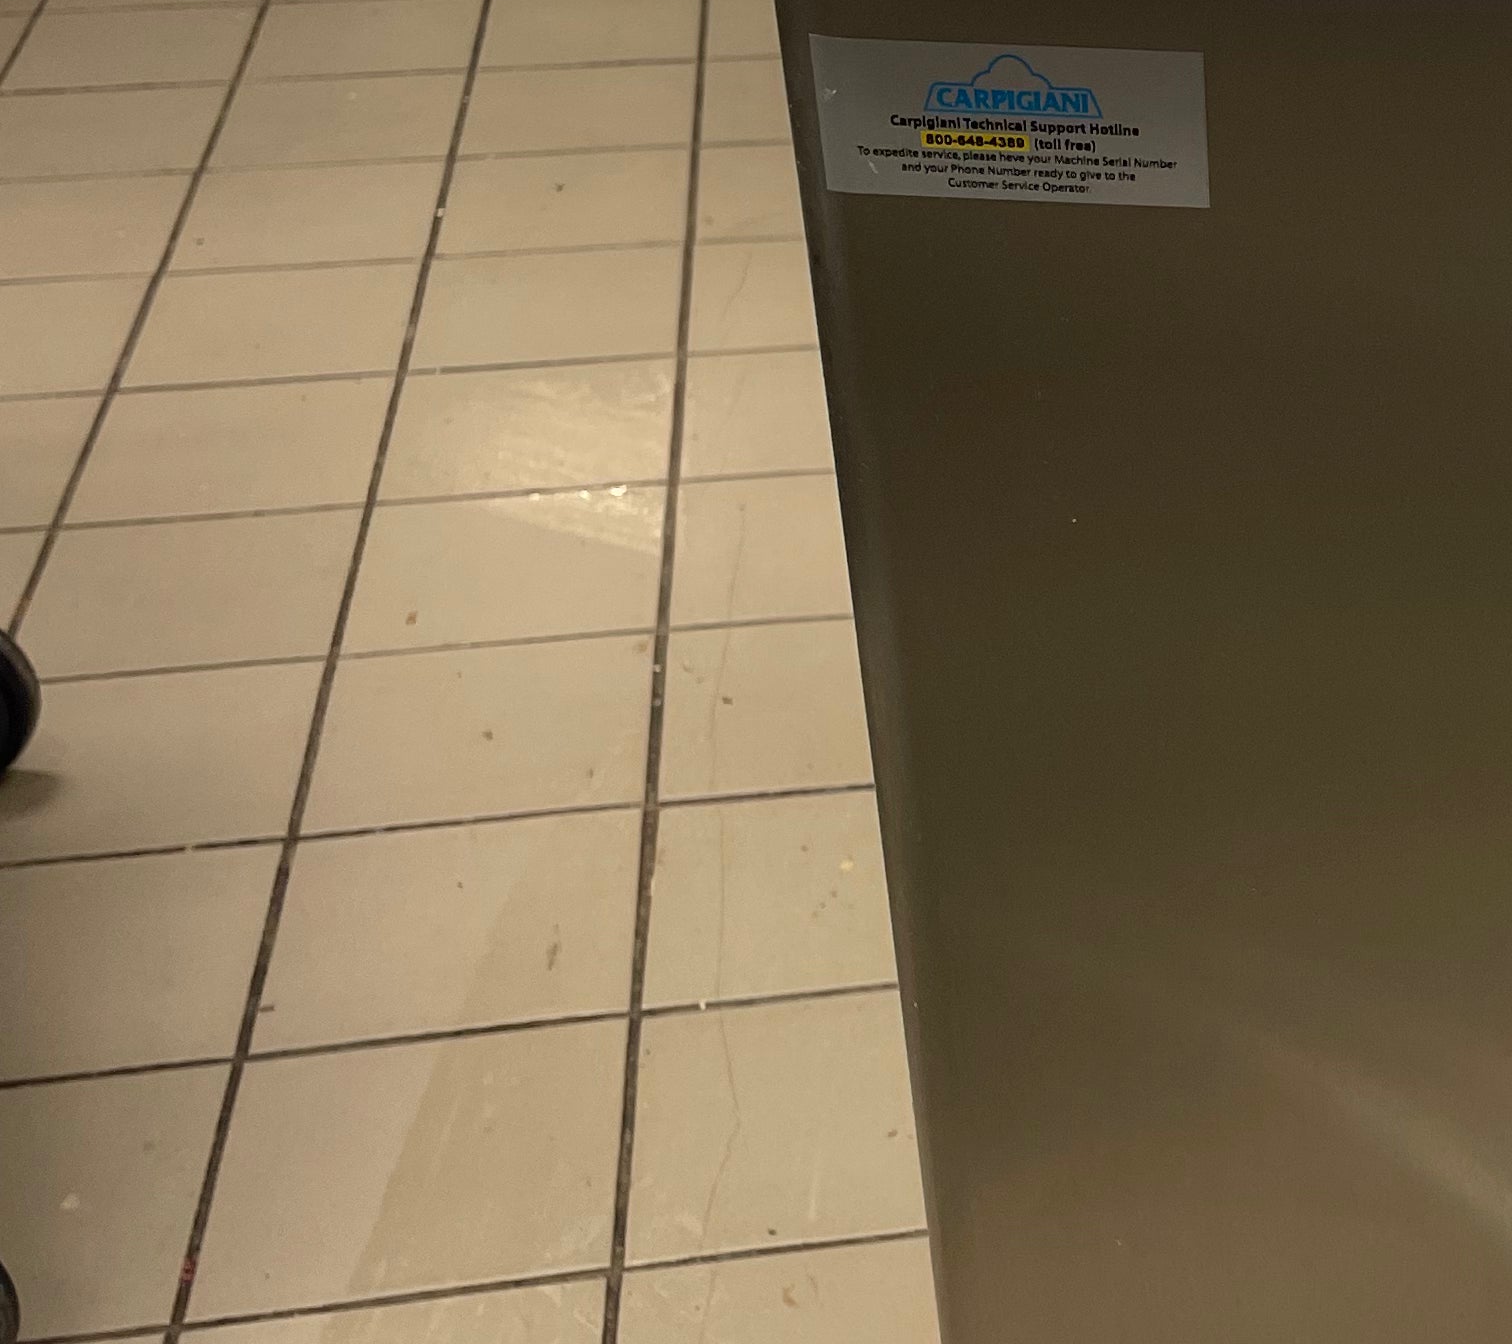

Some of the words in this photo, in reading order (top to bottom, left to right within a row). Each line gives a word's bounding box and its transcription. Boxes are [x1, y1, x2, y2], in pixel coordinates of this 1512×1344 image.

[936, 86, 1090, 114] CARPIGIANI
[890, 114, 961, 130] Carpigiani
[962, 117, 1027, 132] Technical
[1030, 120, 1086, 135] Support
[1089, 123, 1139, 136] Hotline
[1035, 138, 1061, 151] (toll
[1065, 140, 1096, 153] free)
[857, 146, 870, 156] To
[873, 147, 919, 159] expedite
[922, 150, 961, 161] service,
[963, 151, 997, 162] please
[1028, 155, 1051, 165] your
[1054, 154, 1099, 166] Machine
[1102, 157, 1131, 167] Serial
[1134, 158, 1178, 169] Number
[902, 163, 921, 172] and
[924, 165, 948, 174] your
[951, 164, 985, 174] Phone
[988, 166, 1030, 177] Number
[1033, 169, 1063, 180] ready
[1066, 170, 1077, 178] to
[1080, 171, 1101, 181] give
[1104, 172, 1115, 180] to
[1118, 172, 1135, 181] the
[948, 178, 999, 189] Customer
[1002, 180, 1039, 191] Service
